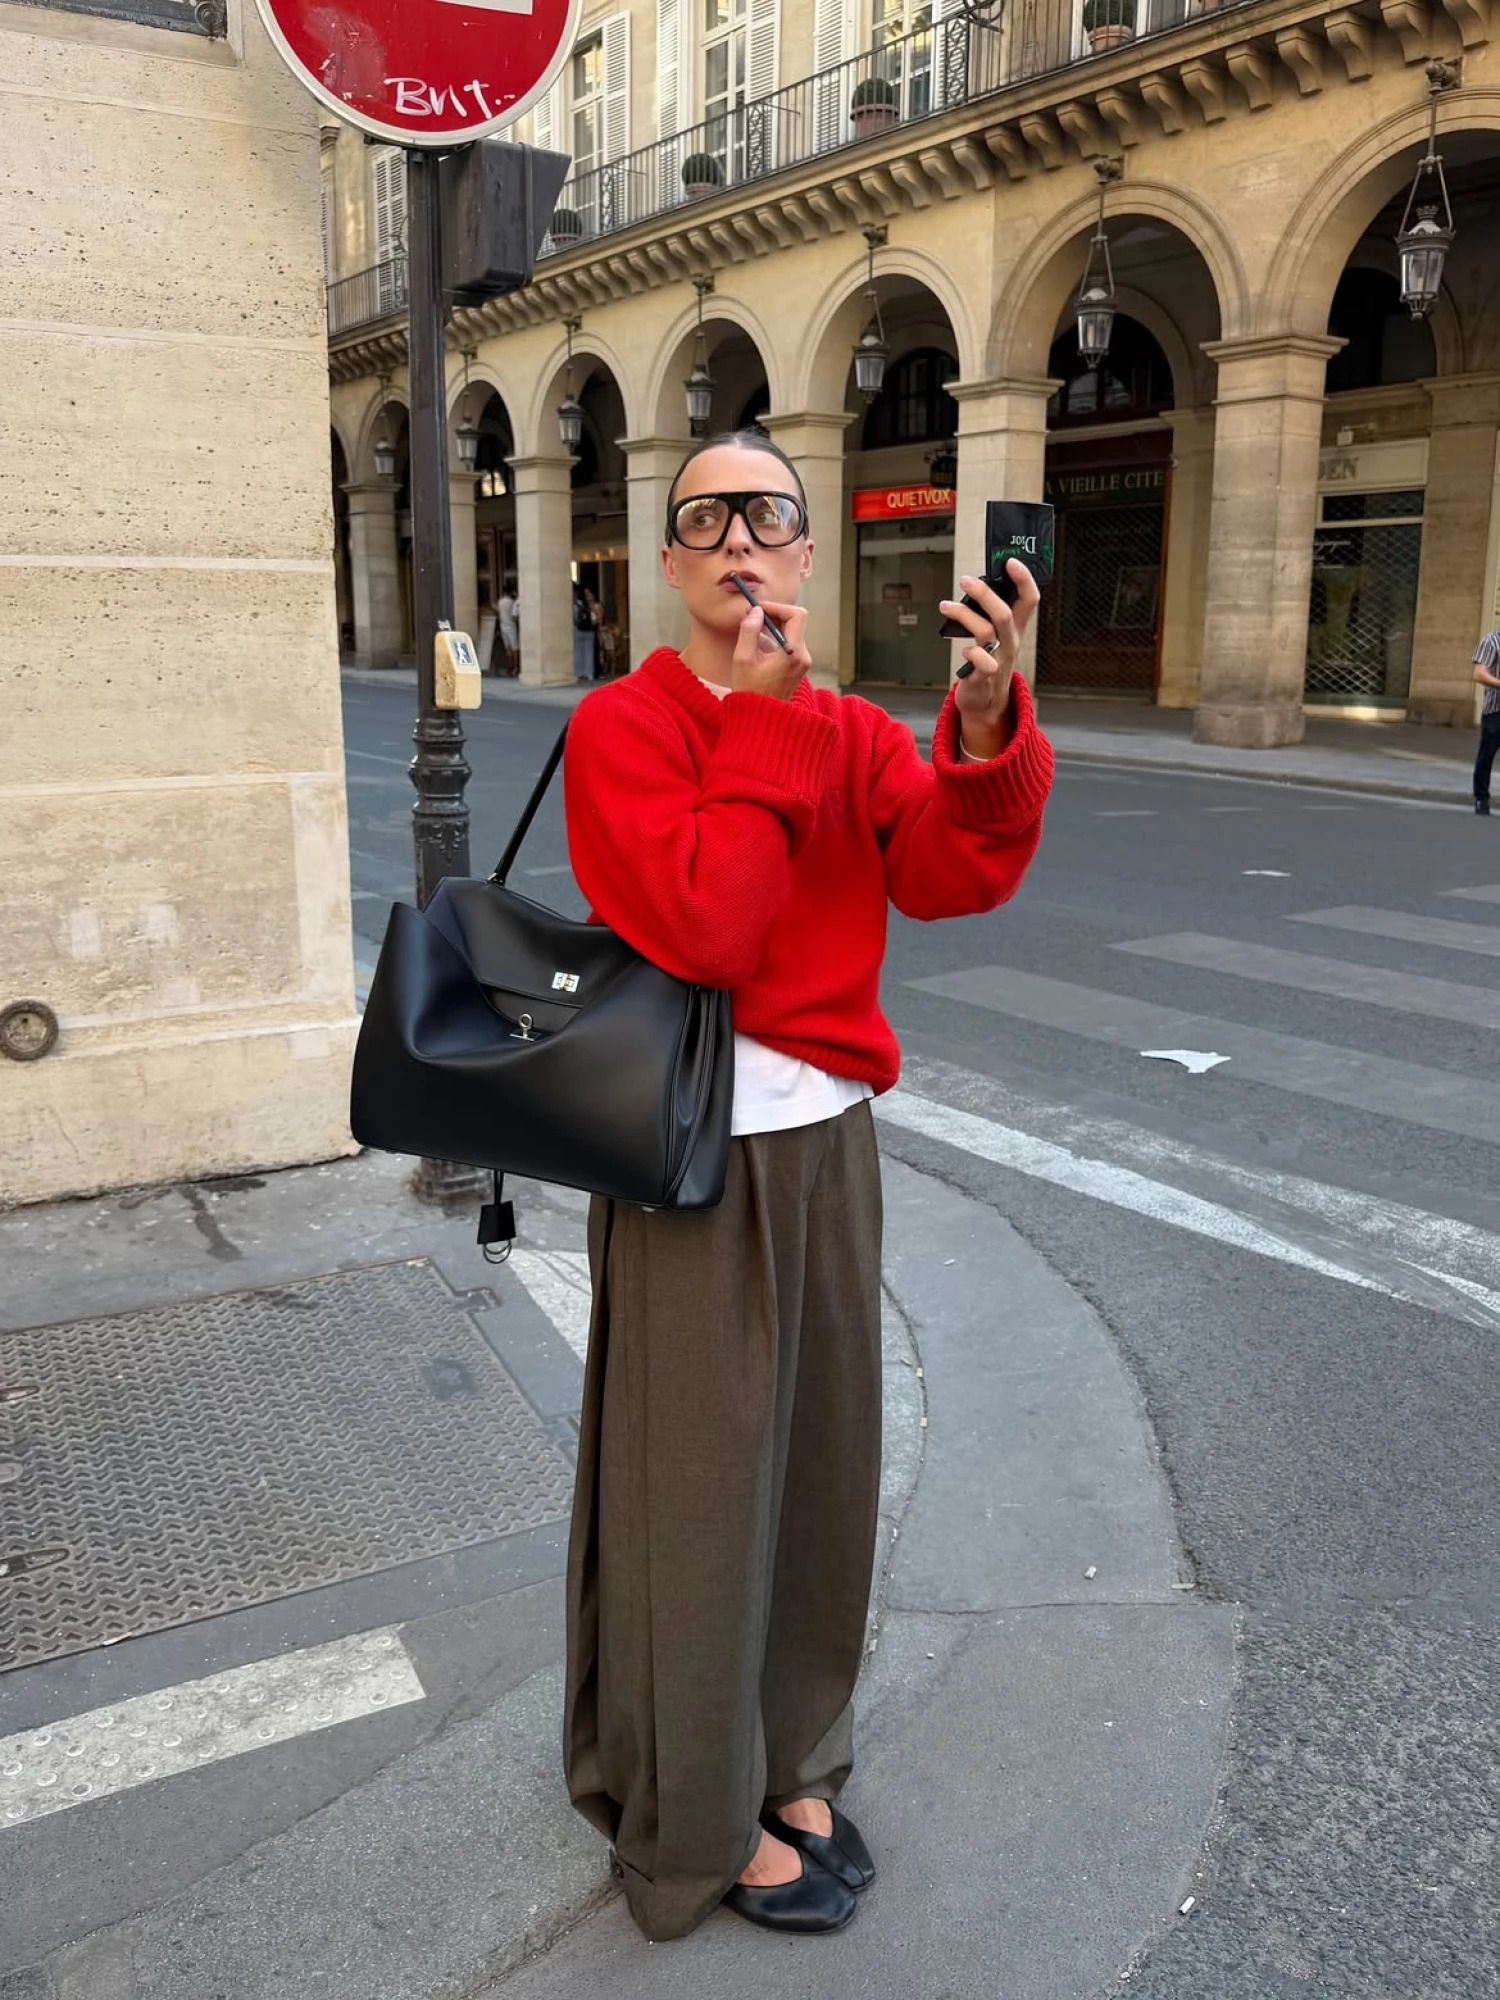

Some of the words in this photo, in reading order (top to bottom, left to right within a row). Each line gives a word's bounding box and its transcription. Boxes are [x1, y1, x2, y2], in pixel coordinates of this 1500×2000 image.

[1058, 474, 1120, 493] VIEILLE
[886, 488, 951, 509] QUIETVOX
[1010, 535, 1037, 555] Dior
